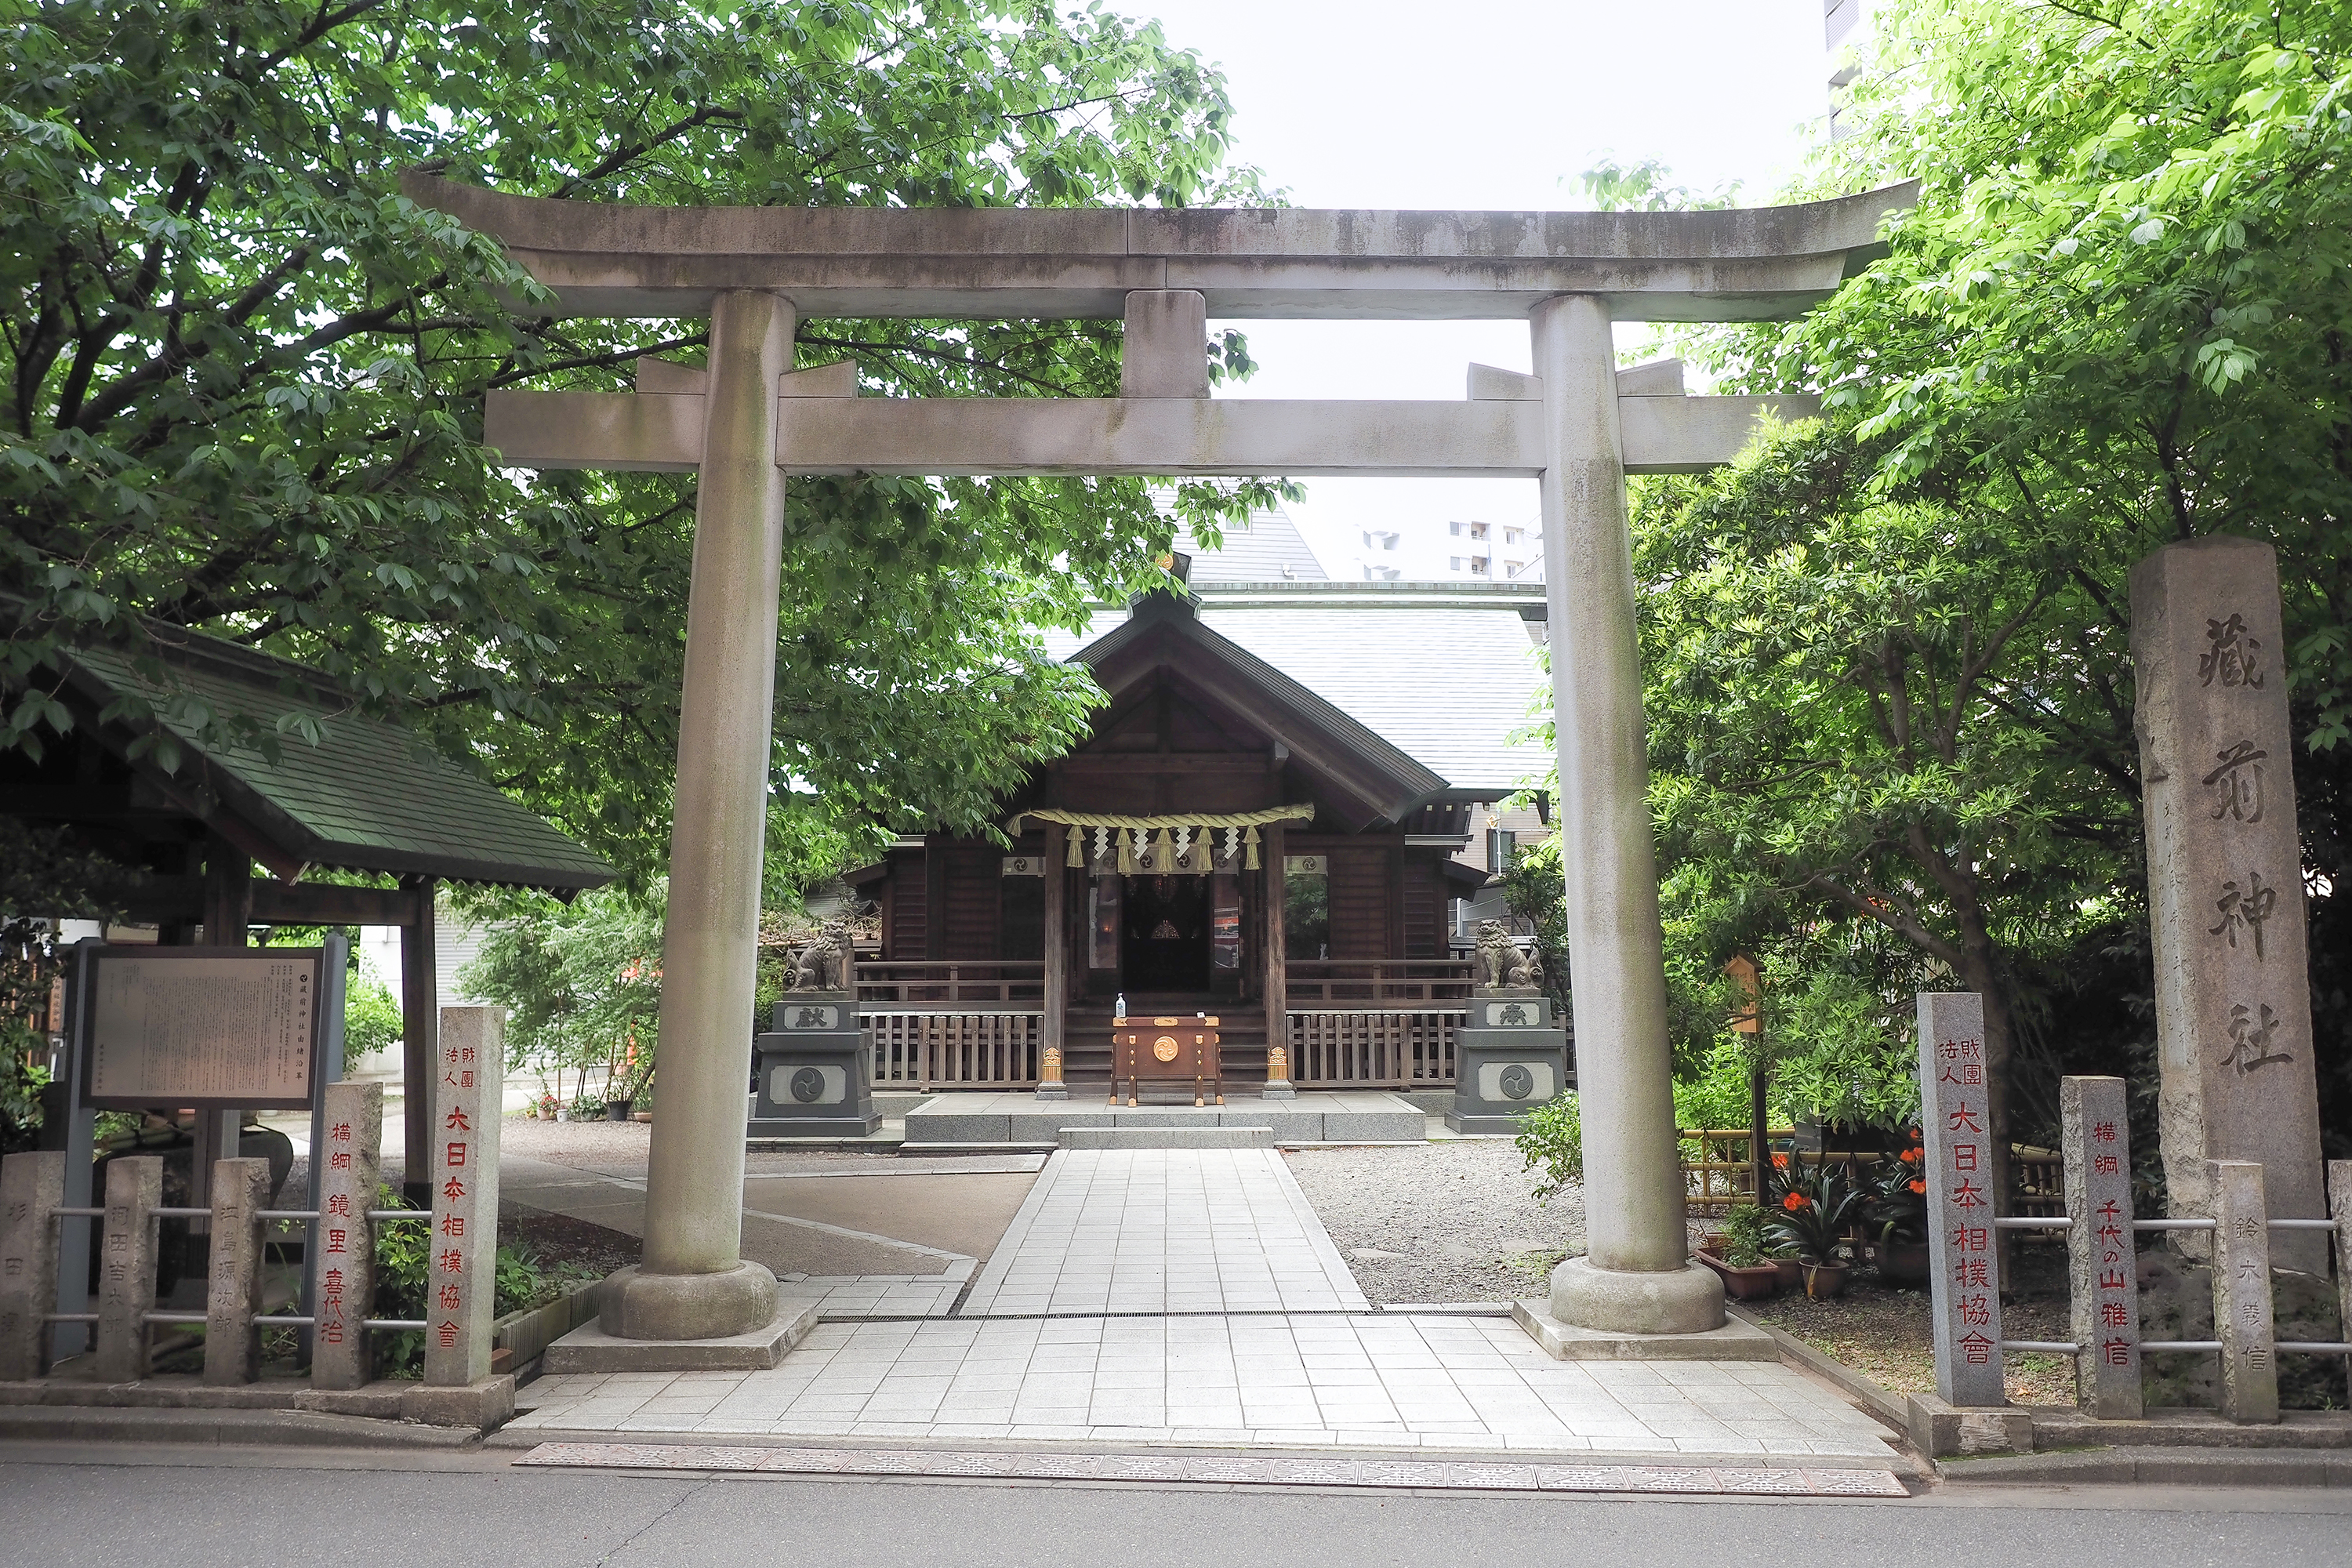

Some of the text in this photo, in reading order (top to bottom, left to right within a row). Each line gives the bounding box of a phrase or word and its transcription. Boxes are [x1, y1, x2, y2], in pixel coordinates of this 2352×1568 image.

[1500, 1002, 1527, 1025] 奉
[2232, 1217, 2268, 1372] 鈴木義信
